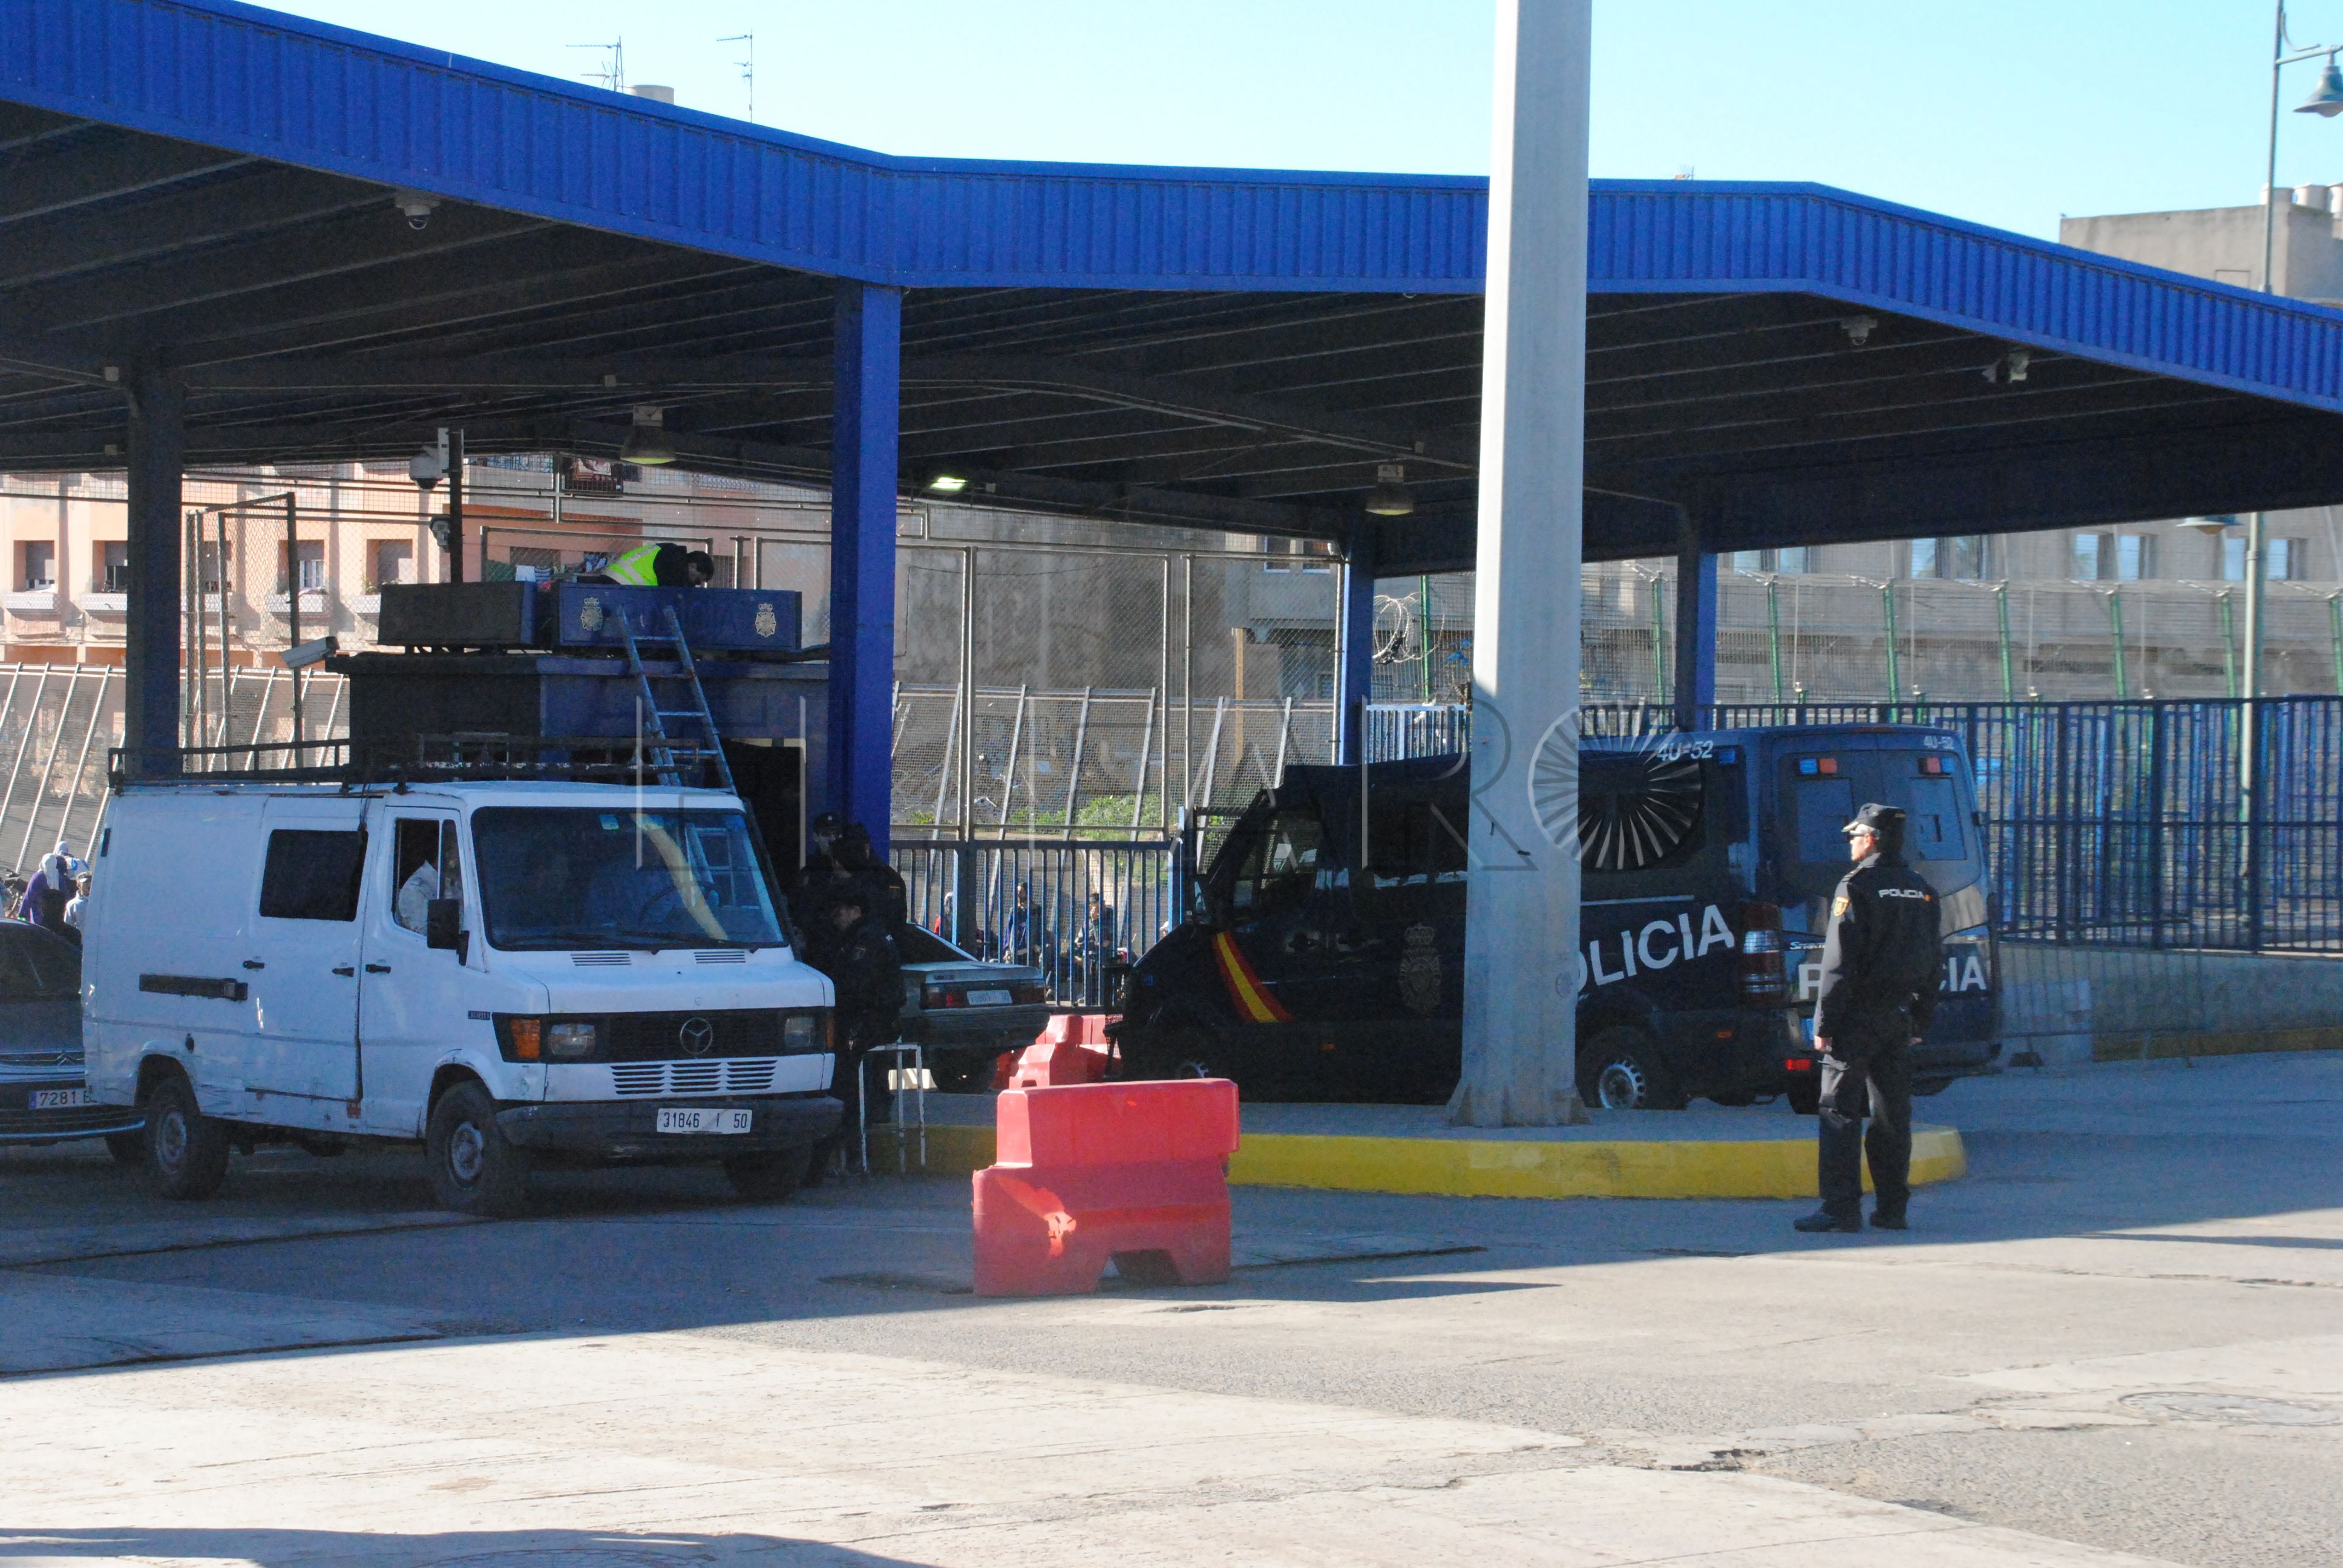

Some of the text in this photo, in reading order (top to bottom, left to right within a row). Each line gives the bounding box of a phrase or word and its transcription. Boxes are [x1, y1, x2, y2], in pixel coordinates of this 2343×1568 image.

[1657, 740, 1714, 762] 4U-52
[1878, 888, 1925, 900] POLICIA
[1578, 904, 1735, 993] LICIA
[40, 1090, 76, 1106] 7281
[663, 1112, 700, 1128] 31846
[733, 1113, 748, 1128] 50
